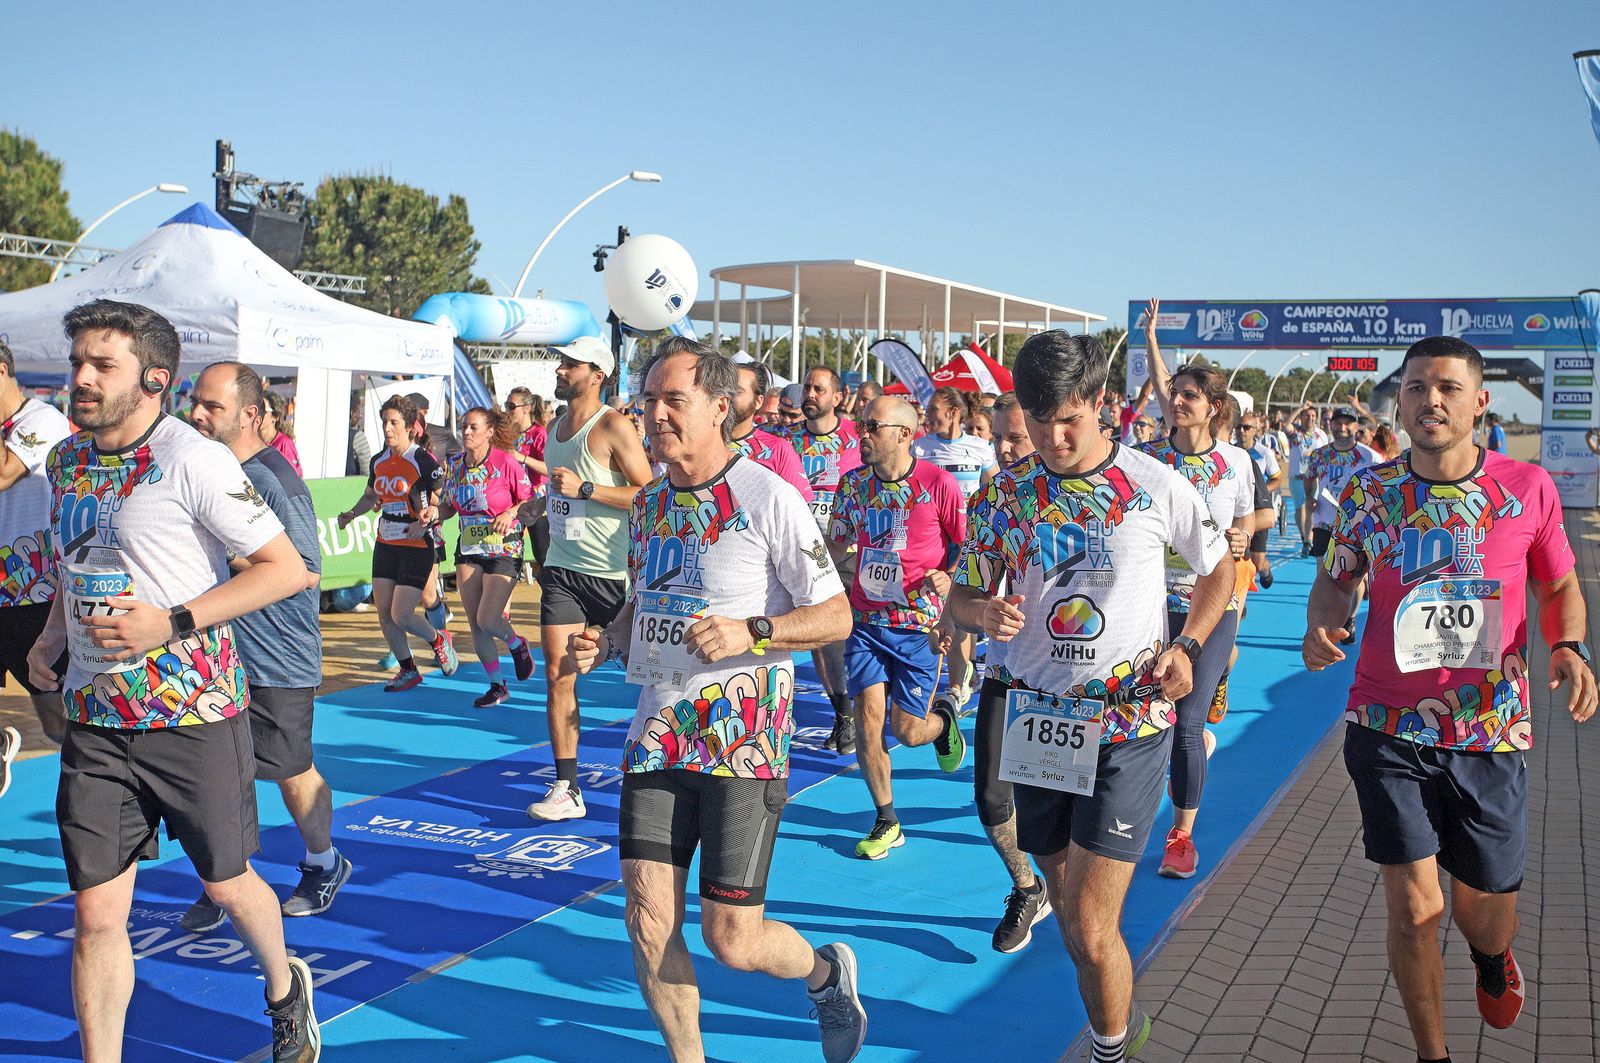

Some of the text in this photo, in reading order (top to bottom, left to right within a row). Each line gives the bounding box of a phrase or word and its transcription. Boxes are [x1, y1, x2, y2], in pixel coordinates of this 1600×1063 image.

[1283, 305, 1389, 318] CAMPEONATO
[1197, 309, 1221, 340] 10
[1282, 318, 1426, 335] de ESPAÑA 10 km
[1441, 308, 1469, 337] 10
[1469, 314, 1514, 329] HUELVA
[273, 327, 324, 350] Cpaim
[1350, 335, 1387, 343] Absoluto
[802, 455, 826, 480] 10
[99, 496, 124, 512] HU
[552, 499, 570, 515] 869
[98, 512, 119, 530] EL
[893, 508, 910, 520] HU
[60, 493, 99, 557] 10
[471, 526, 489, 537] 651
[866, 508, 893, 545] 10
[1087, 521, 1114, 537] HU
[98, 530, 121, 546] VA
[892, 529, 907, 539] VA
[1455, 527, 1485, 543] HU
[685, 538, 709, 554] HU
[1035, 522, 1086, 582] 10
[1088, 537, 1114, 553] EL
[1455, 543, 1485, 559] EL
[646, 536, 684, 590] 10
[684, 553, 706, 570] EL
[1088, 553, 1113, 569] VA
[1400, 528, 1454, 585] 10
[868, 564, 897, 582] 1601
[1454, 558, 1484, 574] VA
[683, 569, 703, 587] VA
[92, 580, 123, 593] 2023
[1463, 585, 1491, 596] 2023
[673, 600, 697, 613] 2023
[1421, 604, 1474, 629] 780
[639, 616, 685, 646] 1856
[1050, 643, 1096, 660] WiHu
[1016, 693, 1030, 712] 10
[1070, 705, 1094, 717] 2023
[1023, 717, 1085, 749] 1855
[1039, 759, 1062, 767] VERGEL
[368, 815, 512, 841] HUELVA
[370, 828, 487, 848] Ayuntamiento
